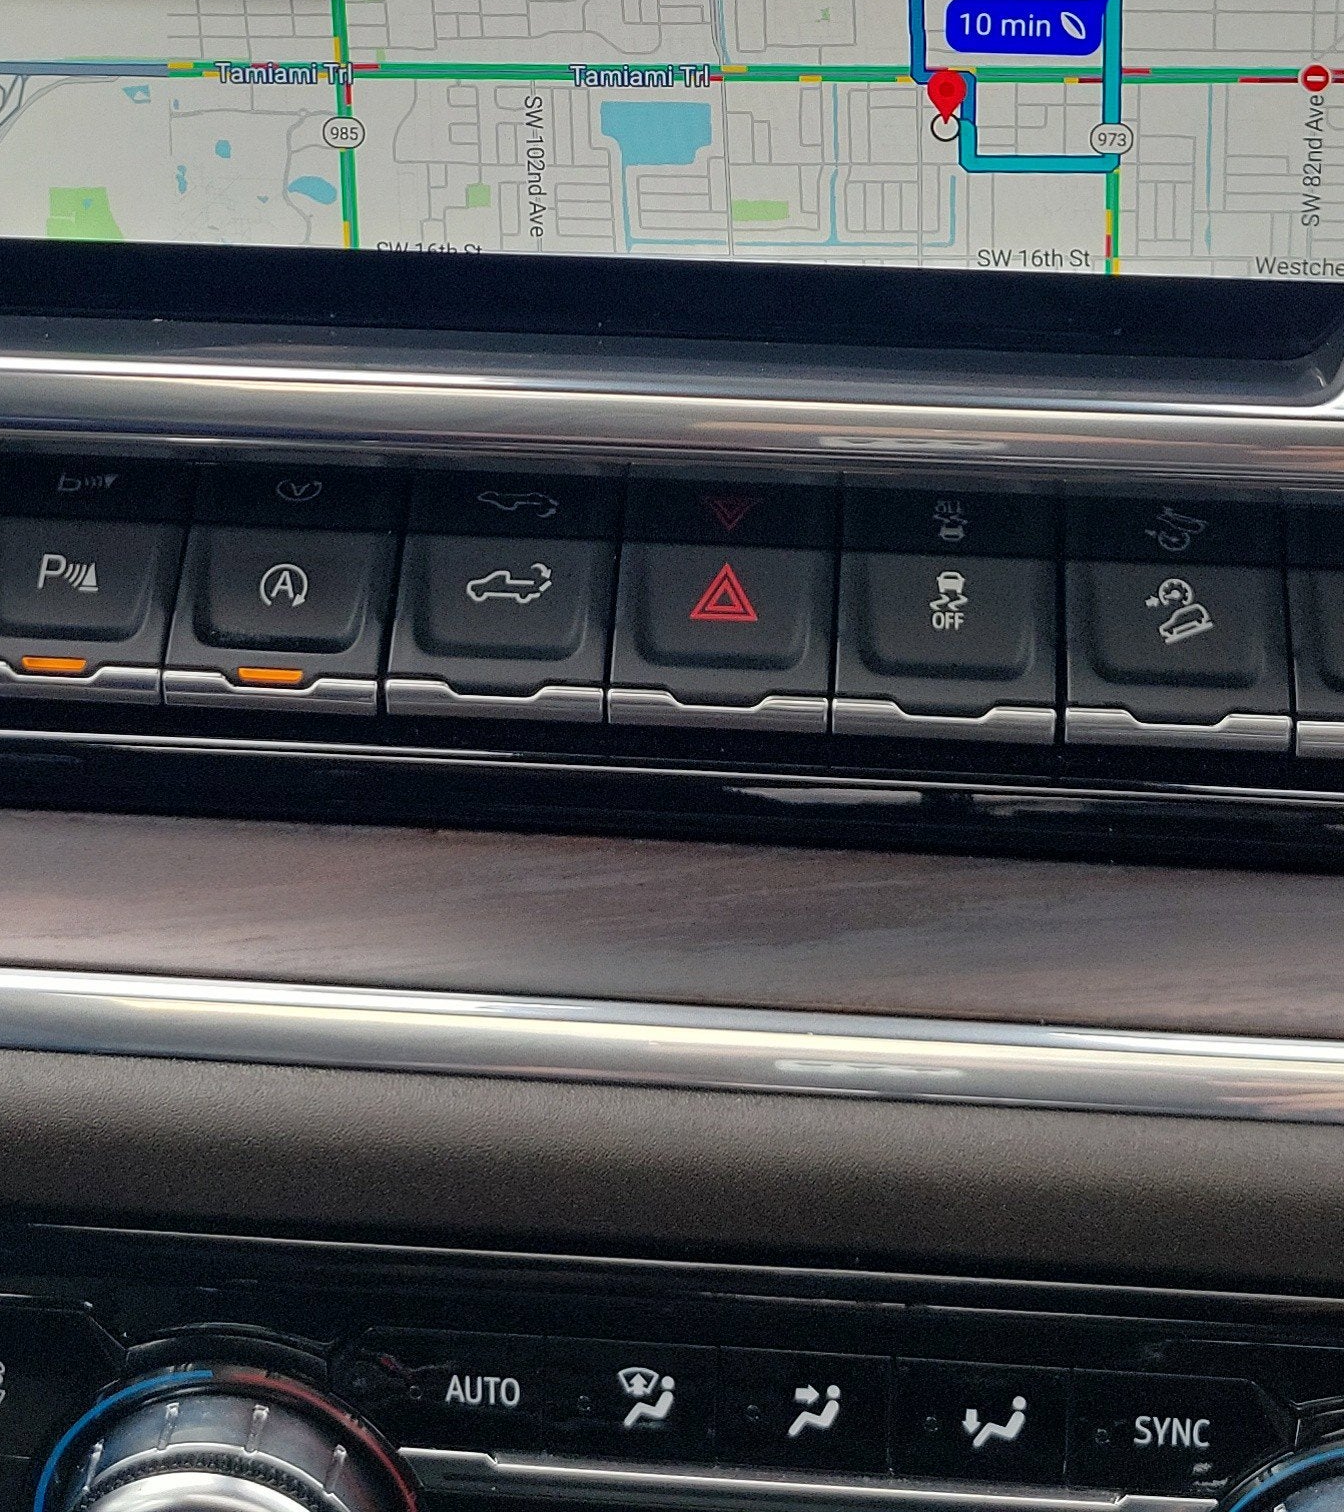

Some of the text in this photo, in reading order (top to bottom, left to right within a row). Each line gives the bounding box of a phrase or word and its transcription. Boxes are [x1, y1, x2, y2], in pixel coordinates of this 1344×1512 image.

[960, 12, 1052, 39] 10 min
[214, 61, 354, 86] Tamiami Trl
[569, 64, 712, 88] Tamiami Trl
[330, 126, 359, 141] 985
[1097, 131, 1127, 148] 973
[524, 95, 547, 237] SW 102nd Ave
[1301, 94, 1325, 227] SW 82nd Ave
[977, 249, 1091, 269] SW 16th St
[932, 611, 965, 631] OFF
[445, 1374, 522, 1407] AUTO
[1133, 1415, 1211, 1449] SYNC
